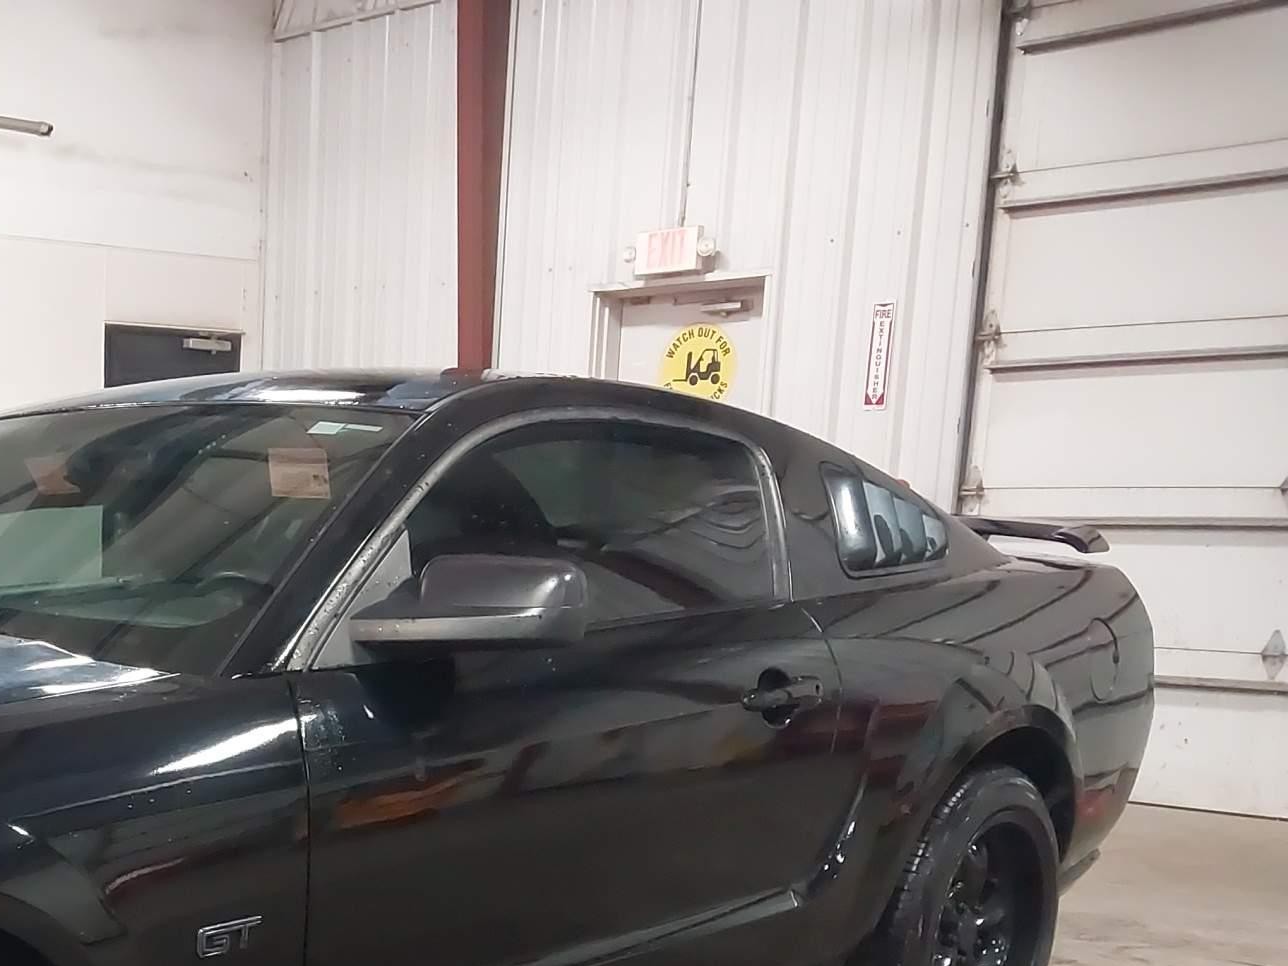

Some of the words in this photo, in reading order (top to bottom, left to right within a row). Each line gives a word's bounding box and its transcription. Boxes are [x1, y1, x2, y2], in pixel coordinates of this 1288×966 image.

[647, 229, 688, 268] EXIT
[875, 309, 892, 319] FIRE
[666, 328, 695, 359] WATCH
[697, 326, 716, 340] OUT
[715, 335, 731, 357] FOR
[871, 321, 885, 400] EXTINGUISHER
[197, 915, 263, 958] GT
